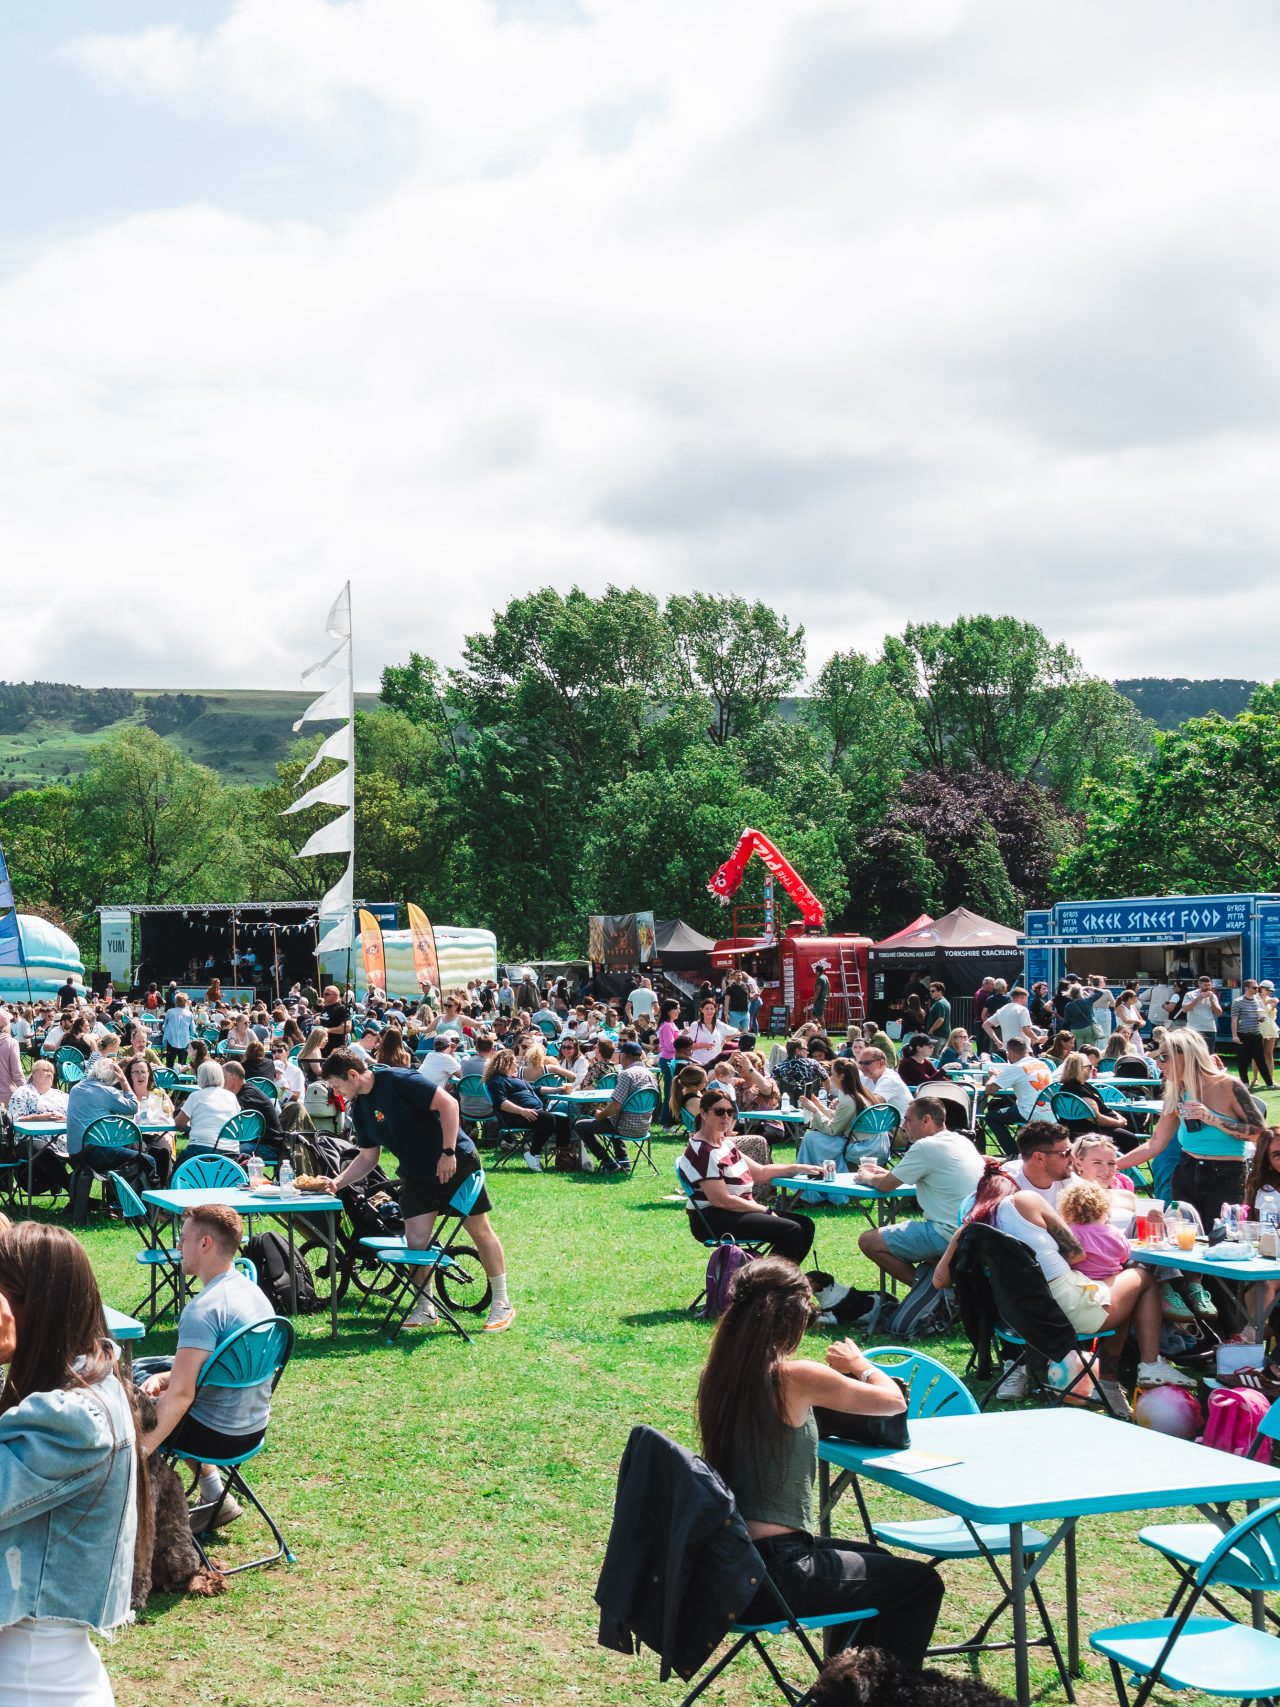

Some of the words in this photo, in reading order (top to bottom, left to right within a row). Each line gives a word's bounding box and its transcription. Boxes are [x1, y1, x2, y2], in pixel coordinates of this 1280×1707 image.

[776, 870, 794, 888] THE
[765, 876, 774, 934] PIZZA
[1226, 904, 1246, 912] GYROS
[1082, 912, 1122, 931] GREEK
[1127, 910, 1175, 929] STREET
[1181, 908, 1221, 928] FOOD
[1227, 912, 1244, 920] PITTA
[1225, 921, 1246, 929] WRAPS
[1062, 926, 1078, 934] WRAPS
[107, 939, 128, 953] YUM.
[981, 949, 1018, 957] CRACKLING
